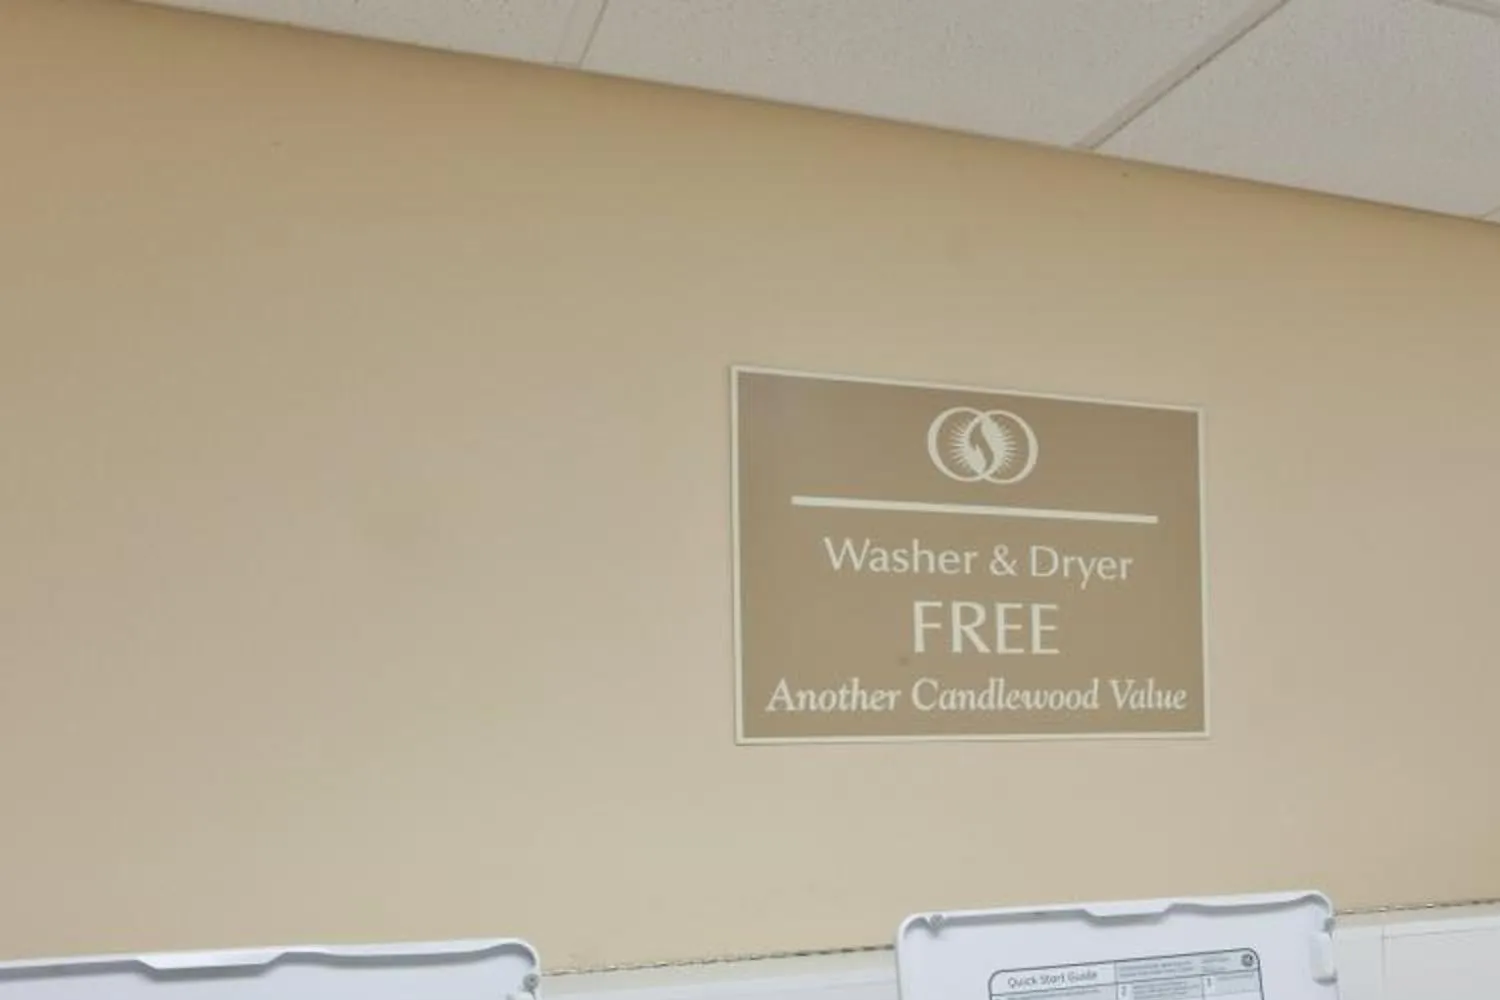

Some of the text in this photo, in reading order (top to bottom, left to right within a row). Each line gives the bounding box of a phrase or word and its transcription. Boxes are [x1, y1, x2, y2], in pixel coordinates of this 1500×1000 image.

[823, 536, 1134, 590] Washer & Dryer
[913, 600, 1060, 654] FREE
[765, 677, 1188, 712] Another Candlewood Value
[1007, 969, 1098, 989] Quick Start Guide
